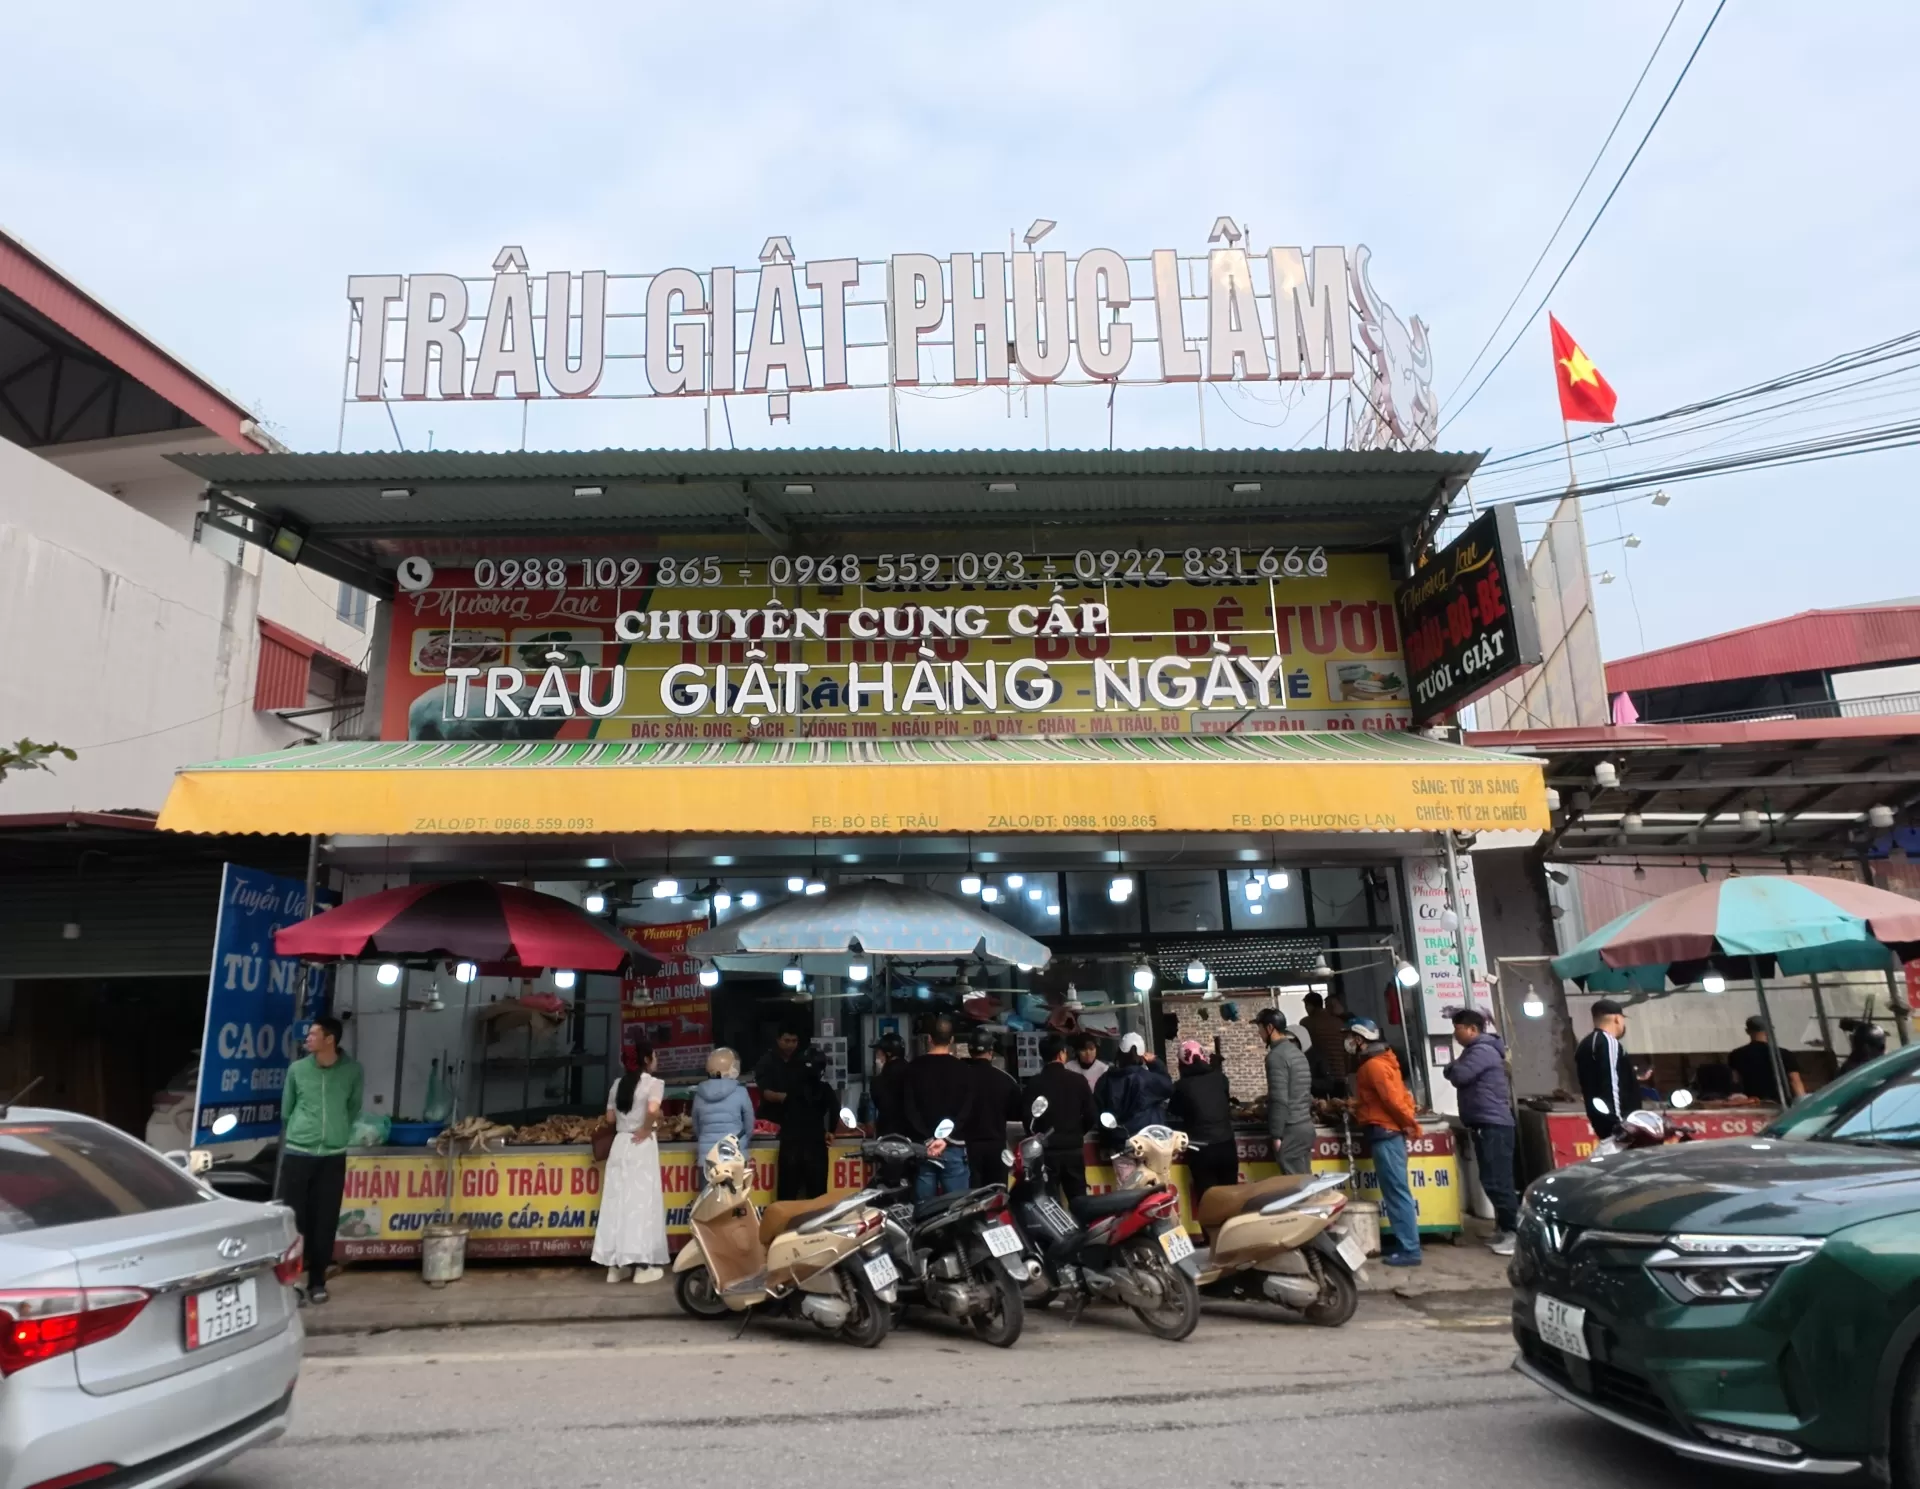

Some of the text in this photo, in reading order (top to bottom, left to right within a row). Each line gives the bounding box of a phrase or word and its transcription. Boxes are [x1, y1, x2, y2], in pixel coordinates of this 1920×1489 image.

[348, 215, 1355, 418] TRÂU GIẬT PHÚC LÂM
[474, 557, 568, 589] 0988
[581, 556, 643, 588] 109
[656, 554, 724, 587] 865
[769, 553, 861, 585] 0968
[875, 552, 941, 584] 559
[958, 551, 1026, 581] 093
[1074, 549, 1167, 580] 0922
[1182, 547, 1243, 577] 831
[1257, 545, 1329, 576] 666
[615, 584, 1109, 642] CHUYÊN CUNG CẤP
[1462, 629, 1505, 674] GIẬT
[444, 652, 625, 720] TRÂU
[660, 648, 811, 728] GIẬT
[848, 645, 1055, 714] HÀNG
[1093, 641, 1284, 711] NGÀY
[703, 722, 732, 738] ONG
[852, 721, 877, 737] TIM
[494, 817, 595, 830] 0968.559.093
[812, 815, 838, 828] FB:
[1062, 815, 1158, 828] 0988.109.865
[1232, 814, 1257, 827] FB:
[1364, 813, 1396, 826] LAN
[218, 1022, 275, 1060] CAO
[506, 1161, 563, 1196] TRÂU
